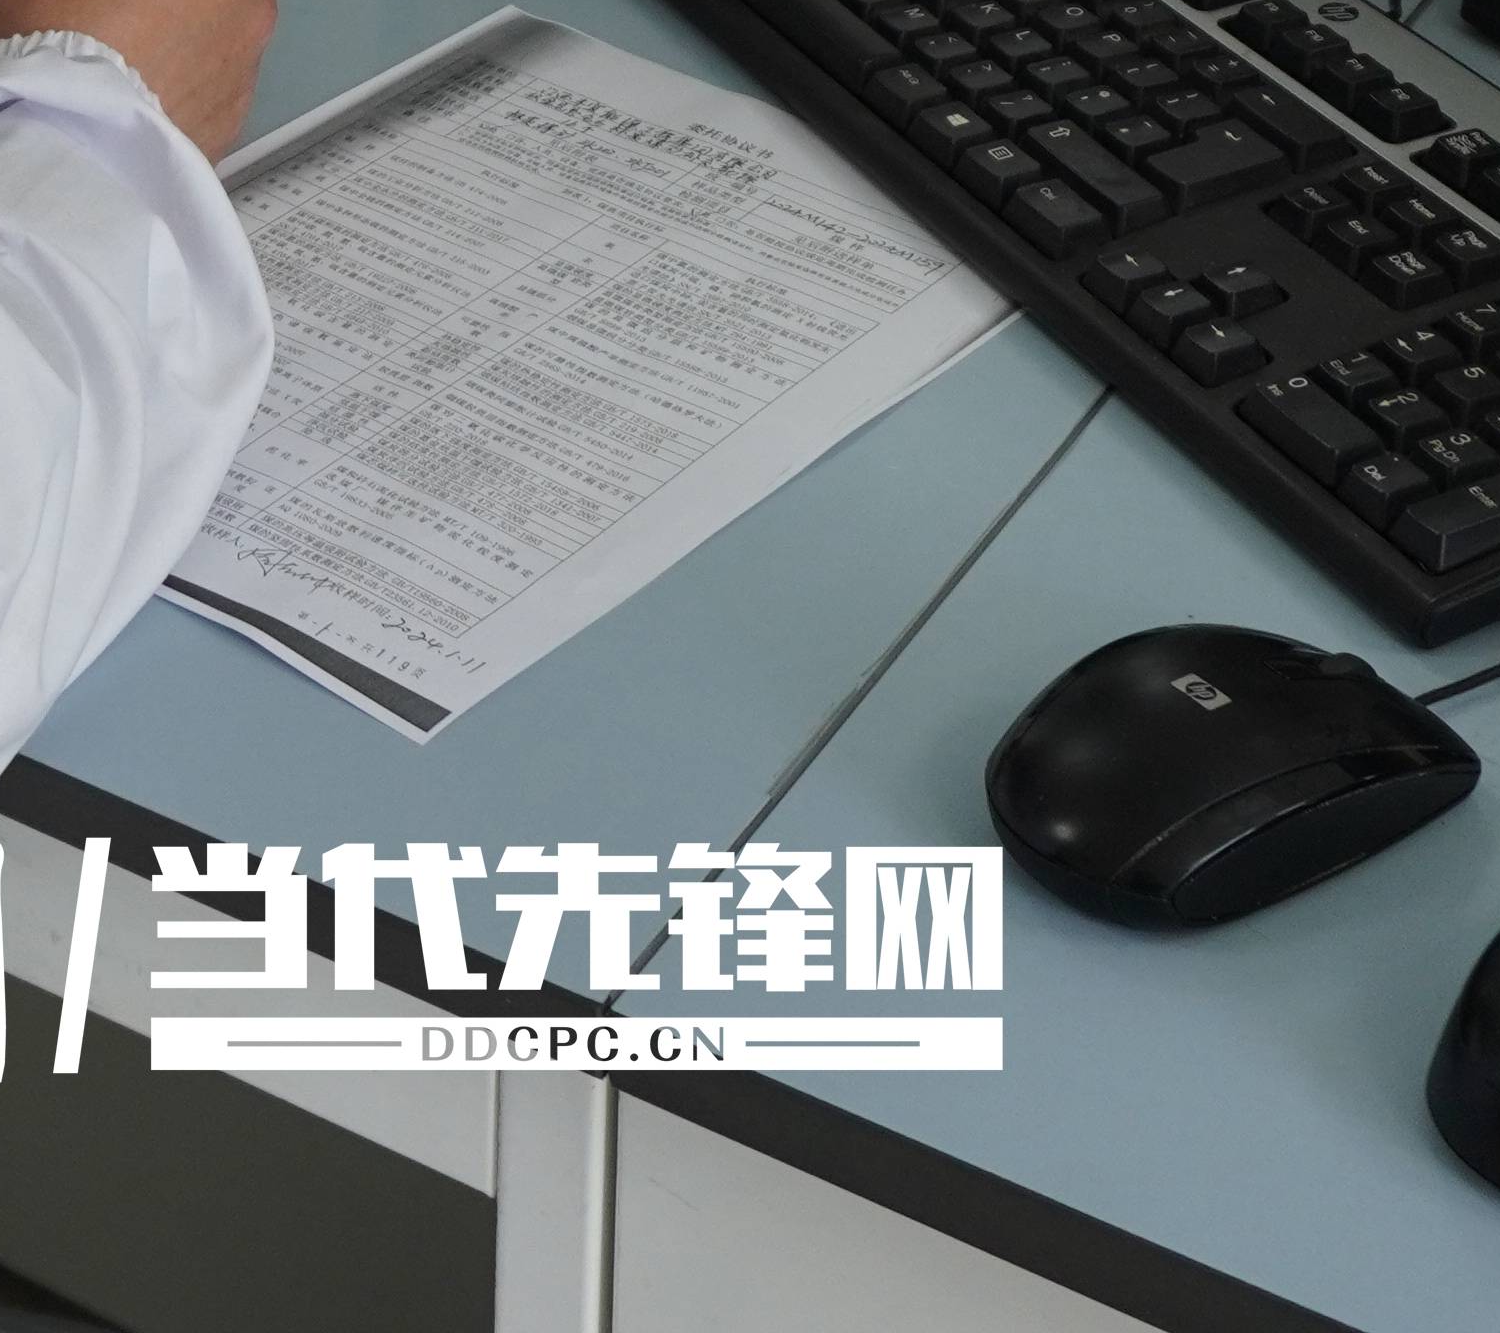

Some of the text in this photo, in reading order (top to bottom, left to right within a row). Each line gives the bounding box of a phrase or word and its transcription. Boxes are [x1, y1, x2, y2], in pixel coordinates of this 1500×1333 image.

[904, 6, 924, 20] M
[979, 2, 999, 15] K
[1066, 6, 1084, 18] O
[1015, 30, 1031, 41] L
[1102, 33, 1122, 44] P
[1408, 198, 1436, 219] Home
[1348, 219, 1369, 234] End
[1475, 303, 1497, 317] 7
[1455, 311, 1485, 332] Home
[1416, 330, 1435, 343] 4
[1329, 359, 1352, 376] End
[1463, 366, 1485, 379] 5
[1288, 376, 1308, 389] 0
[1267, 382, 1284, 398] Ins
[1397, 392, 1419, 405] 2
[1450, 433, 1471, 446] 3
[1363, 464, 1387, 482] Del
[1468, 484, 1499, 509] Enter
